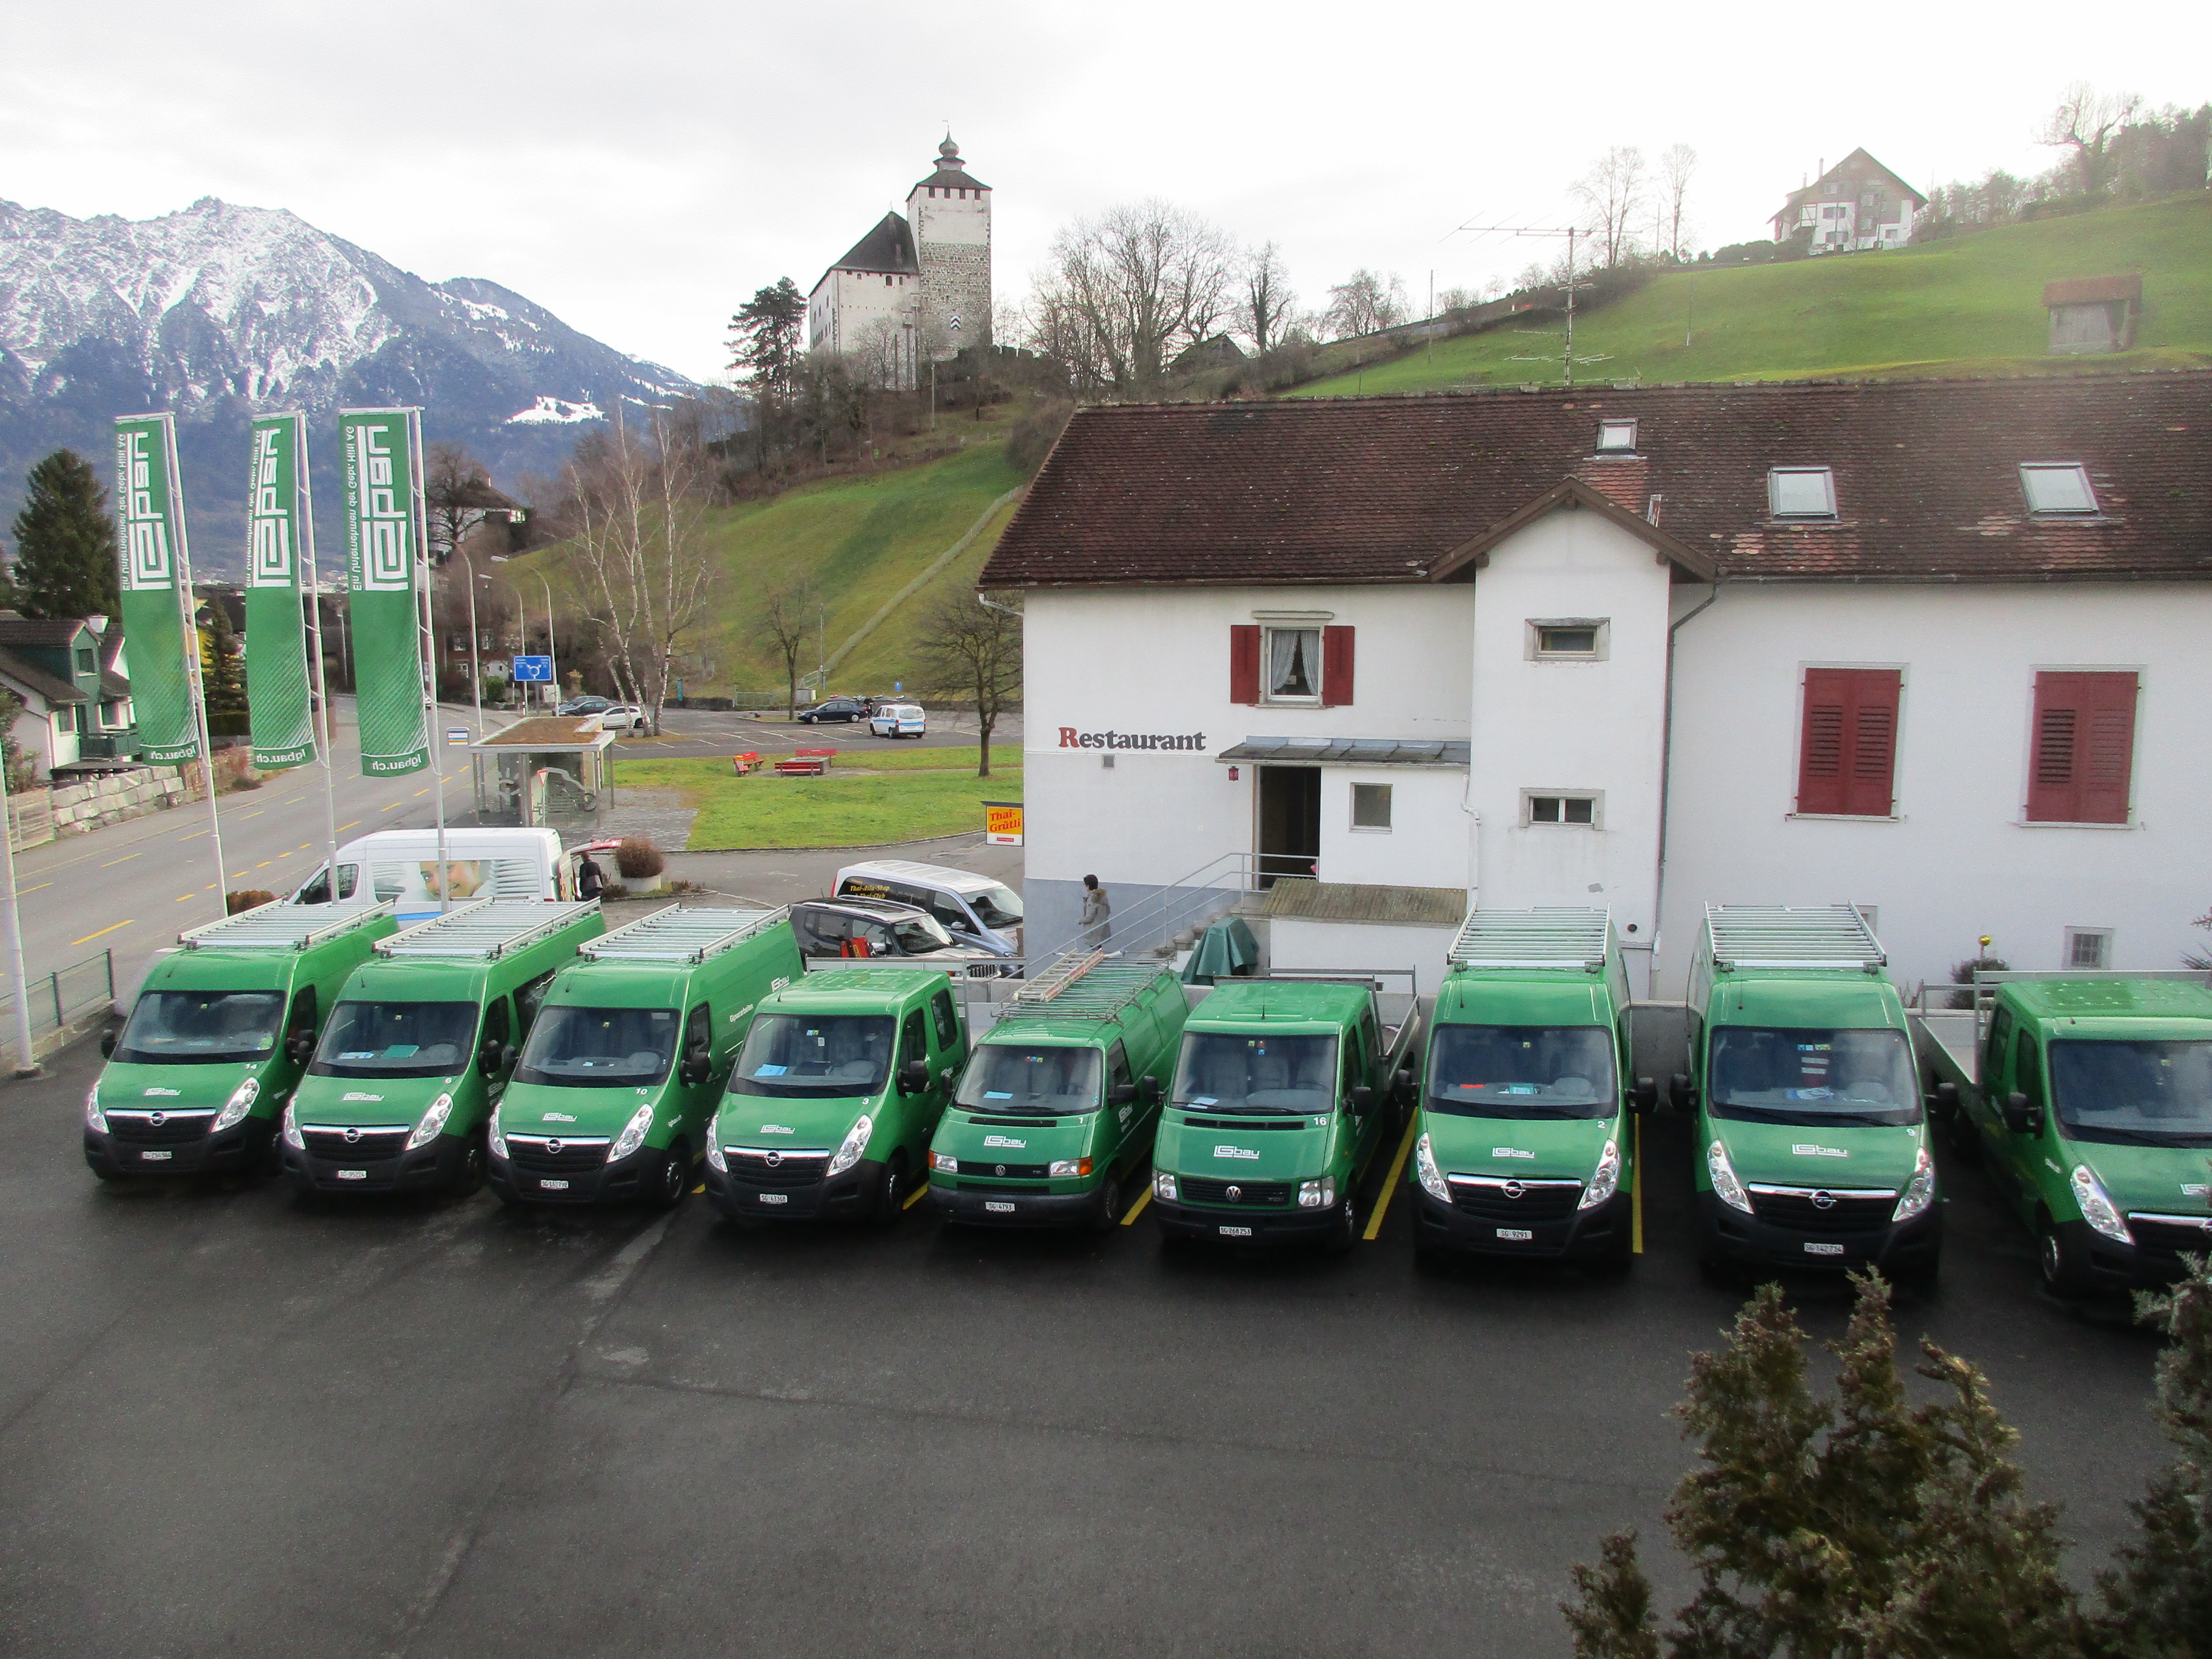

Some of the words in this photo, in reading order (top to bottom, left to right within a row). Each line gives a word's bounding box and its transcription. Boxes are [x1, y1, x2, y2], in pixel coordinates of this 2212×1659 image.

[1058, 726, 1207, 751] Restaurant
[990, 809, 1016, 821] Thai-
[989, 819, 1021, 833] Grütli
[1313, 1117, 1327, 1126] 16
[1597, 1121, 1606, 1129] 2
[1906, 1128, 1915, 1137] 9
